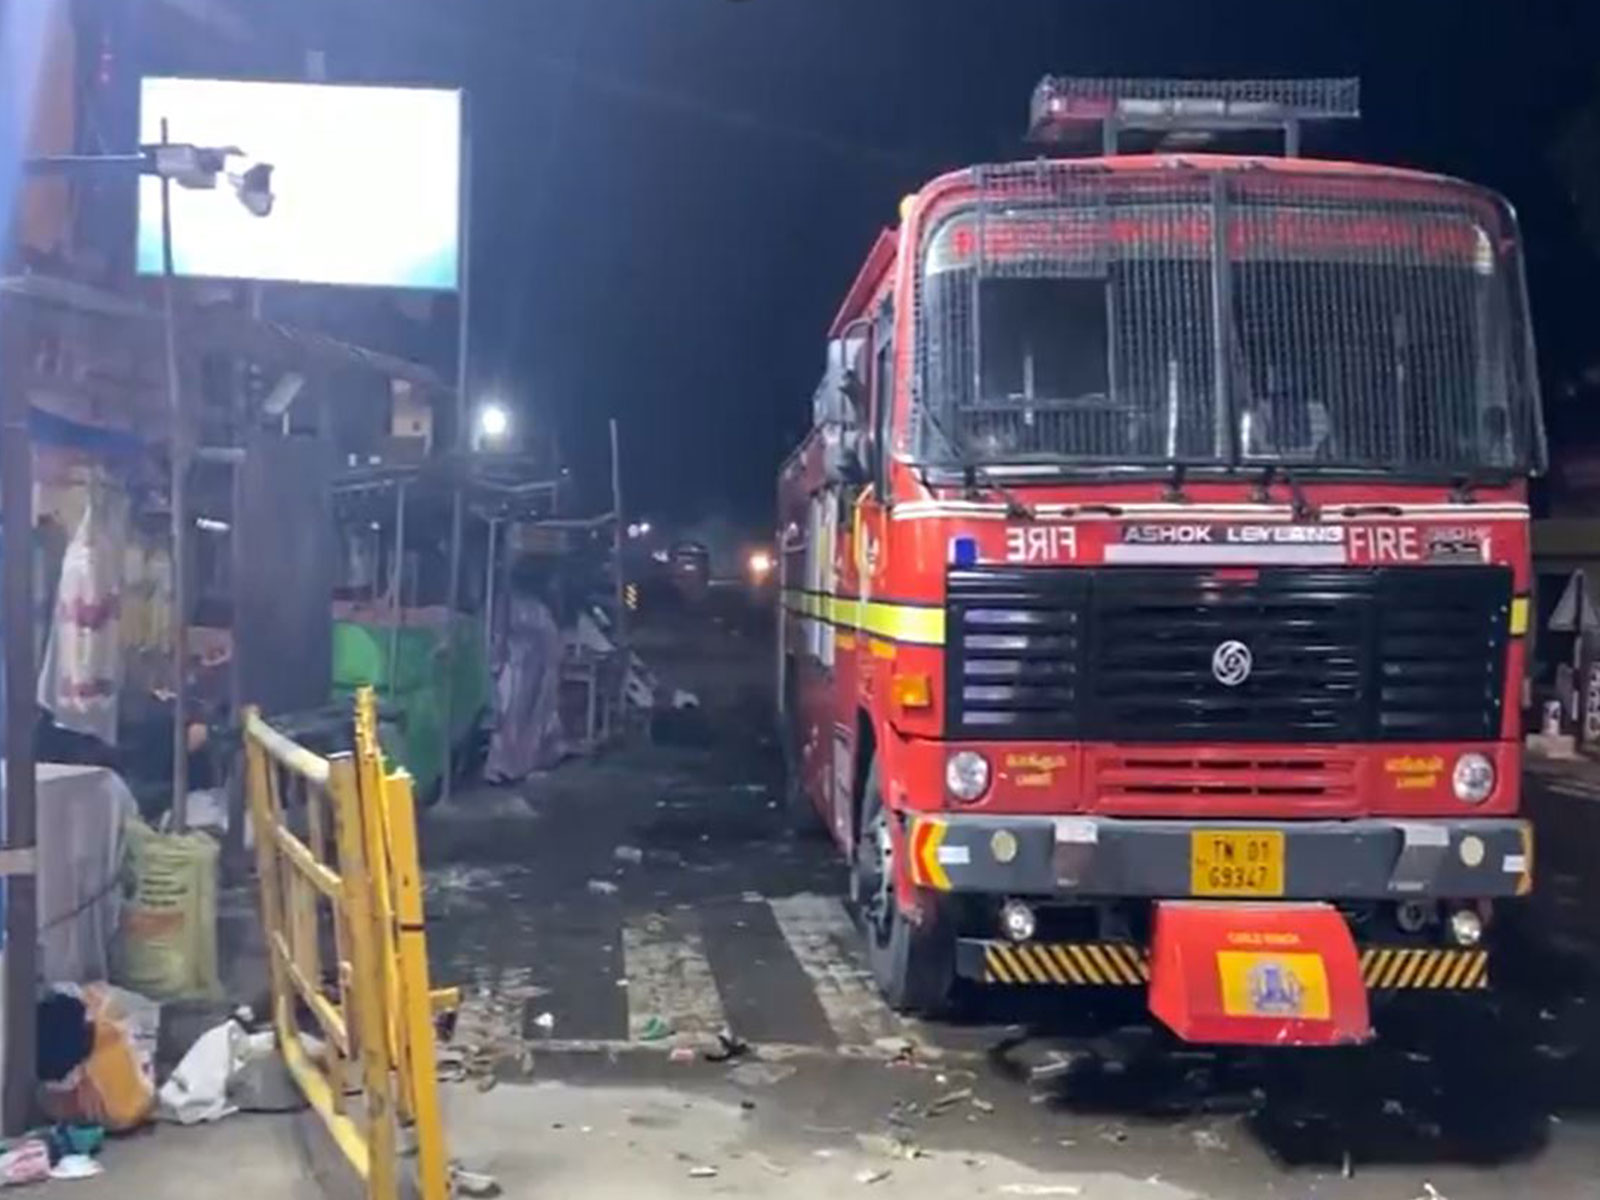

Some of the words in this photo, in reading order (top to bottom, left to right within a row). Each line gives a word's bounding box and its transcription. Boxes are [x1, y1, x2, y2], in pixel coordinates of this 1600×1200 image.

[1124, 525, 1212, 542] ASHOK
[1350, 526, 1419, 560] FIRE
[1213, 840, 1235, 861] TN
[1247, 840, 1270, 861] 01
